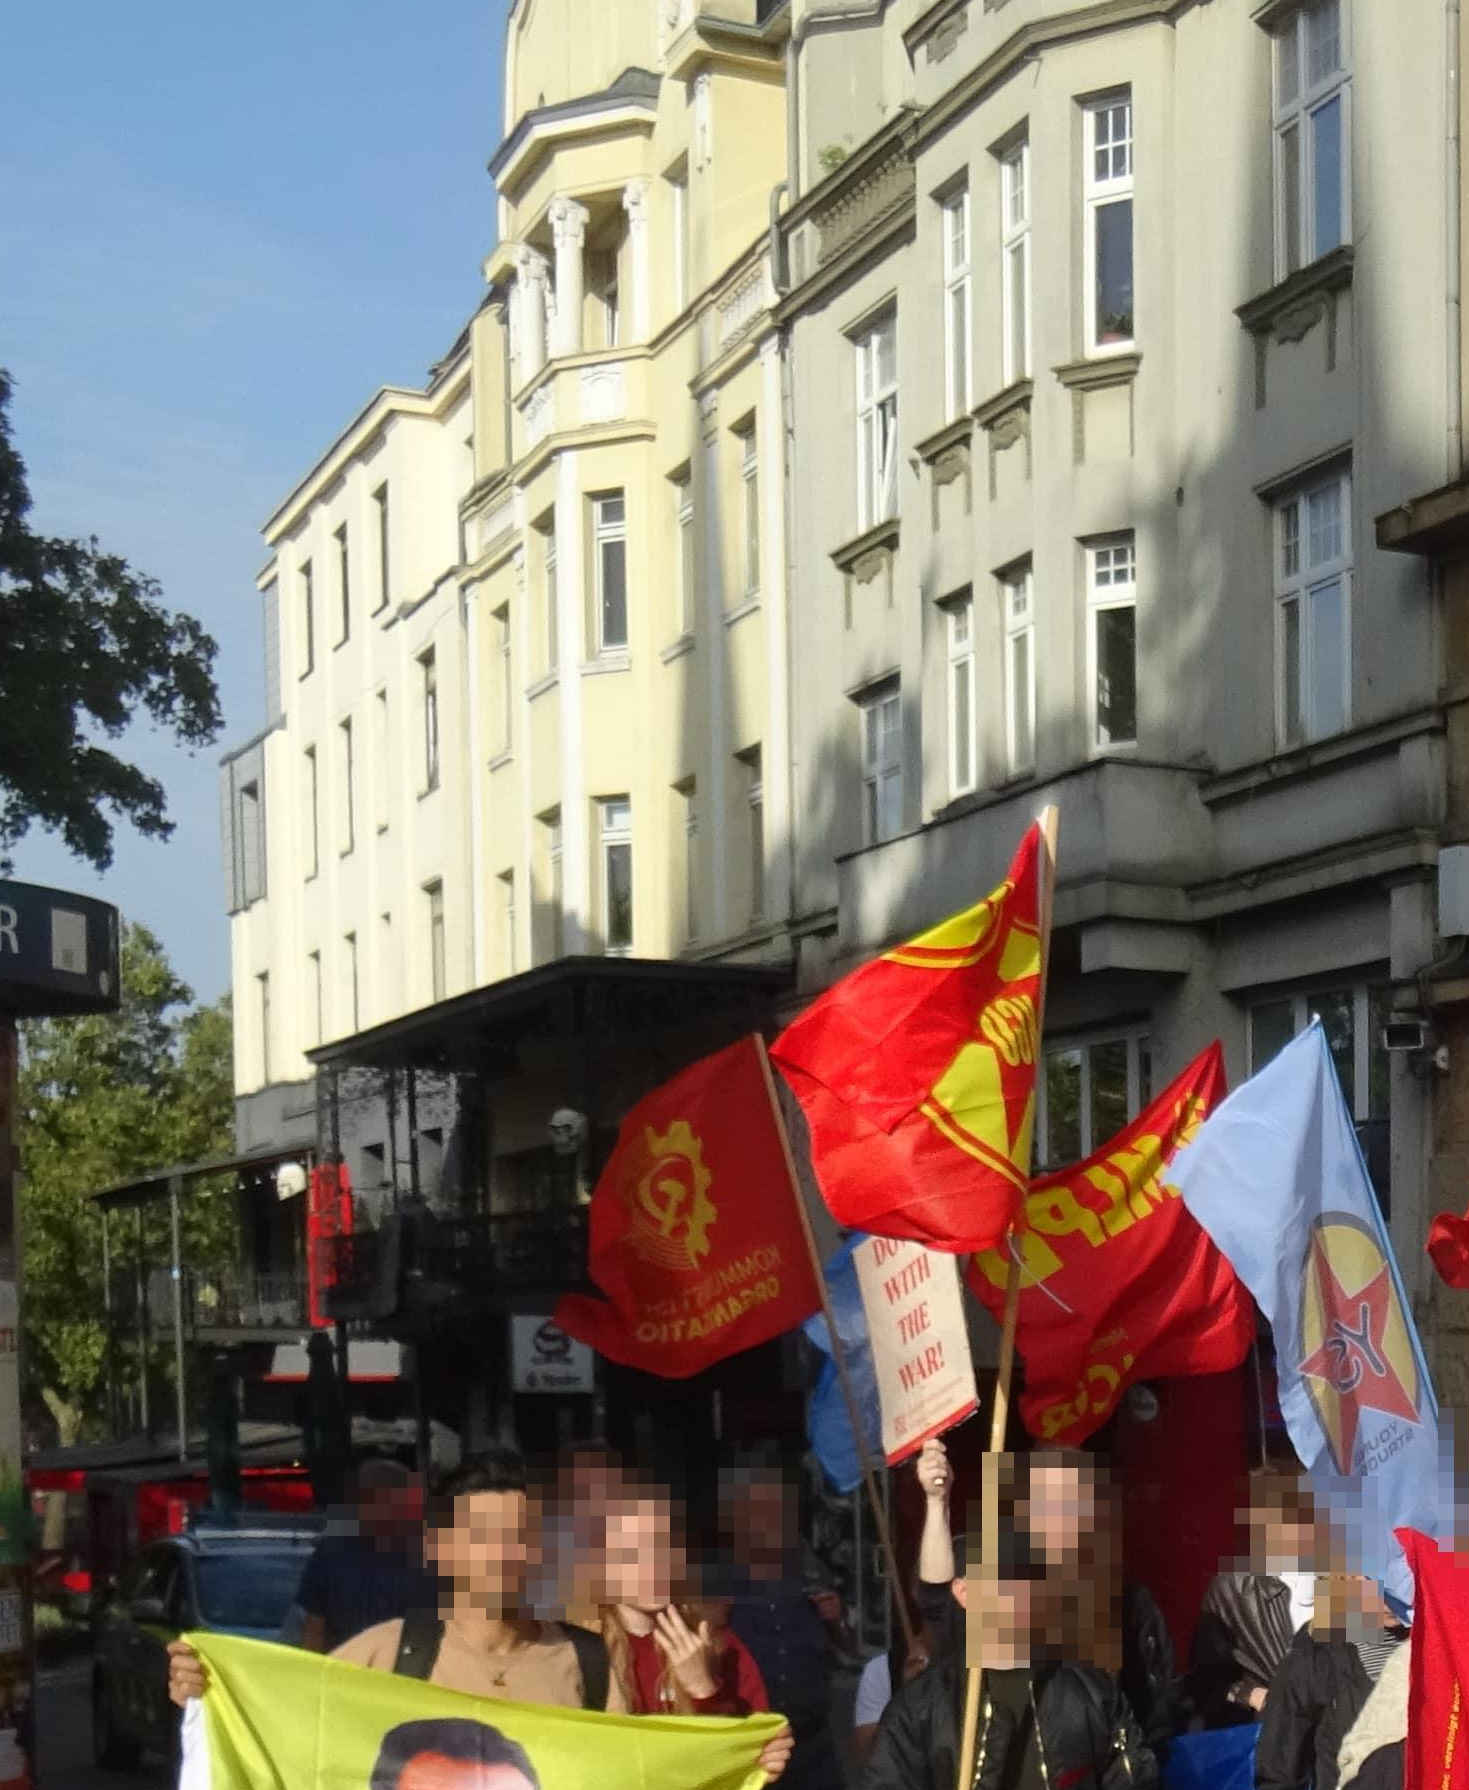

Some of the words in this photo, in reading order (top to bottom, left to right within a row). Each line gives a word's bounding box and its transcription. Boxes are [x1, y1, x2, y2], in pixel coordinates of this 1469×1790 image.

[883, 1254, 931, 1305] WITH
[897, 1301, 932, 1345] THE
[898, 1340, 946, 1393] WAR!
